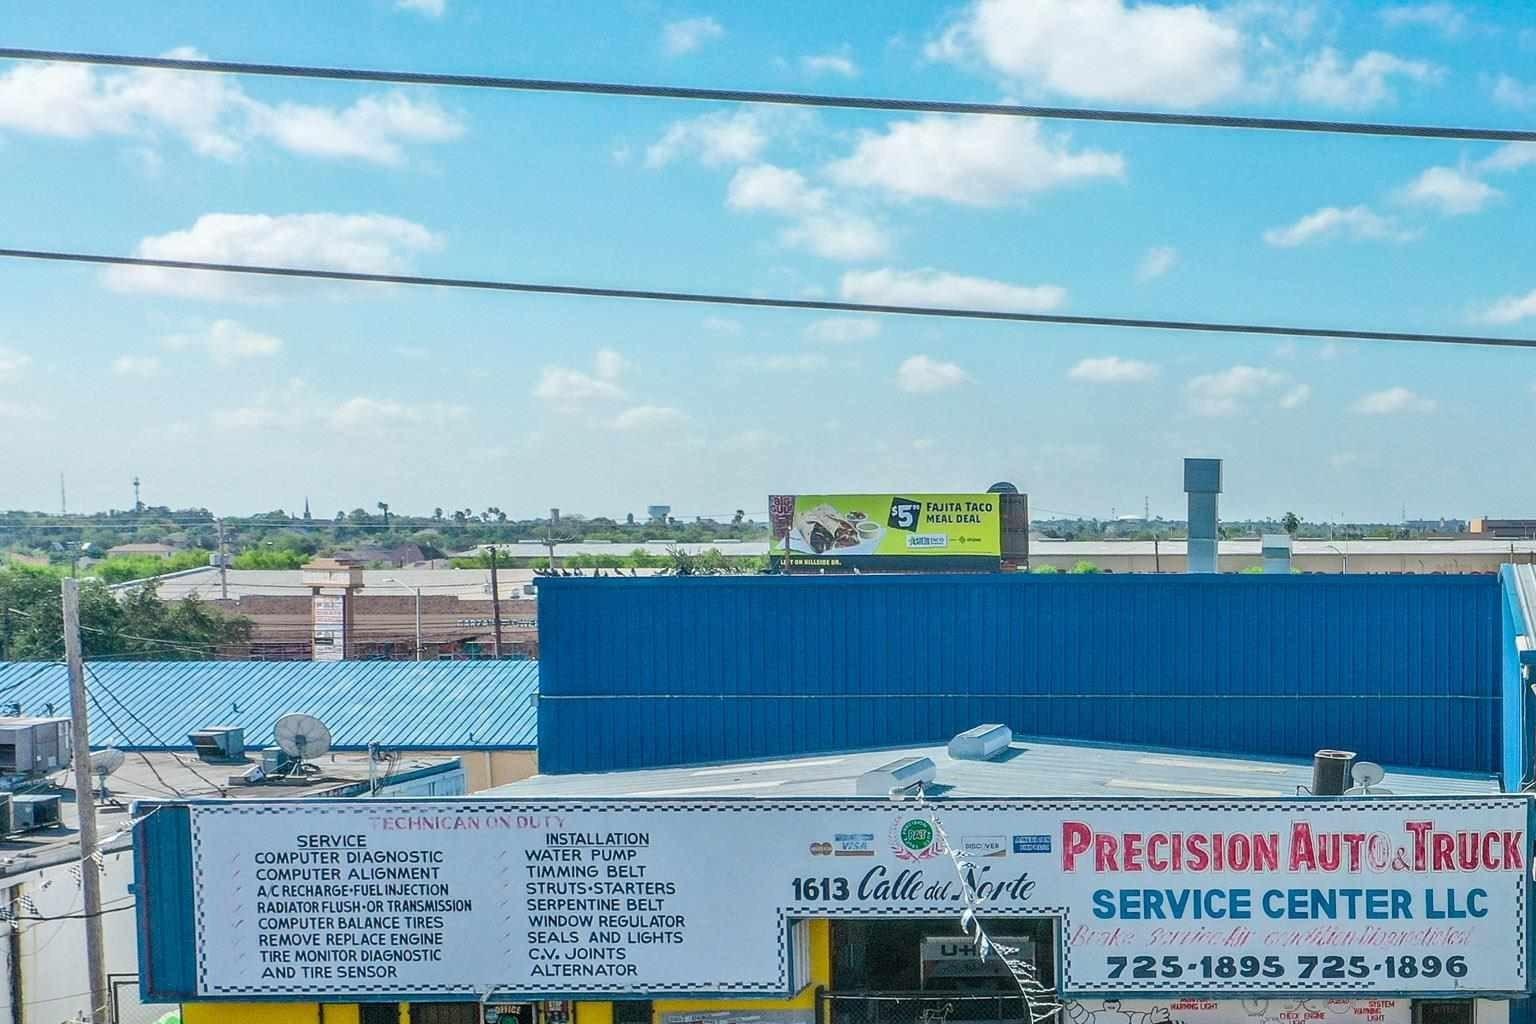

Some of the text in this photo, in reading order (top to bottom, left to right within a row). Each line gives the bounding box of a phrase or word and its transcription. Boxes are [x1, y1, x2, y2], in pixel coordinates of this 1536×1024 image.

[926, 503, 993, 512] FAJITA TACO
[926, 514, 981, 523] MEAL DEAL
[517, 815, 566, 829] DUTY
[297, 834, 367, 848] SERVICE
[546, 832, 649, 846] INSTALLATION
[1062, 821, 1280, 872] PRECISION
[1288, 820, 1391, 872] AUTO
[1405, 820, 1524, 871] TRUCK
[255, 851, 443, 864] COMPUTER DIAGNOSTIC
[525, 849, 637, 861] WATER PUMP
[256, 867, 441, 881] COMPUTER ALIGNMENT
[526, 865, 647, 878] TIMMING BELT
[792, 877, 849, 900] 1613
[858, 865, 924, 900] Calle
[257, 885, 280, 898] A/C
[385, 883, 449, 896] INJECTION
[257, 901, 319, 914] RADIATOR
[388, 900, 472, 912] TRANSMISSION
[527, 899, 665, 911] SERPENTINE BELT
[1092, 888, 1489, 920] SERVICE CENTER LLC
[258, 916, 444, 930] COMPUTER BALANCE TIRES
[529, 915, 686, 928] WINDOW REGULATOR
[259, 932, 443, 947] REMOVE REPLACE ENGINE
[527, 931, 684, 944] SEALS AND LIGHTS
[260, 949, 442, 963] TIRE MONITOR DIAGNOSTIC
[529, 947, 627, 960] C.V. JOINTS
[262, 965, 397, 979] AND TIRE SENSOR
[531, 964, 638, 977] ALTERNATOR
[1107, 955, 1468, 979] 725-1895 725-1896
